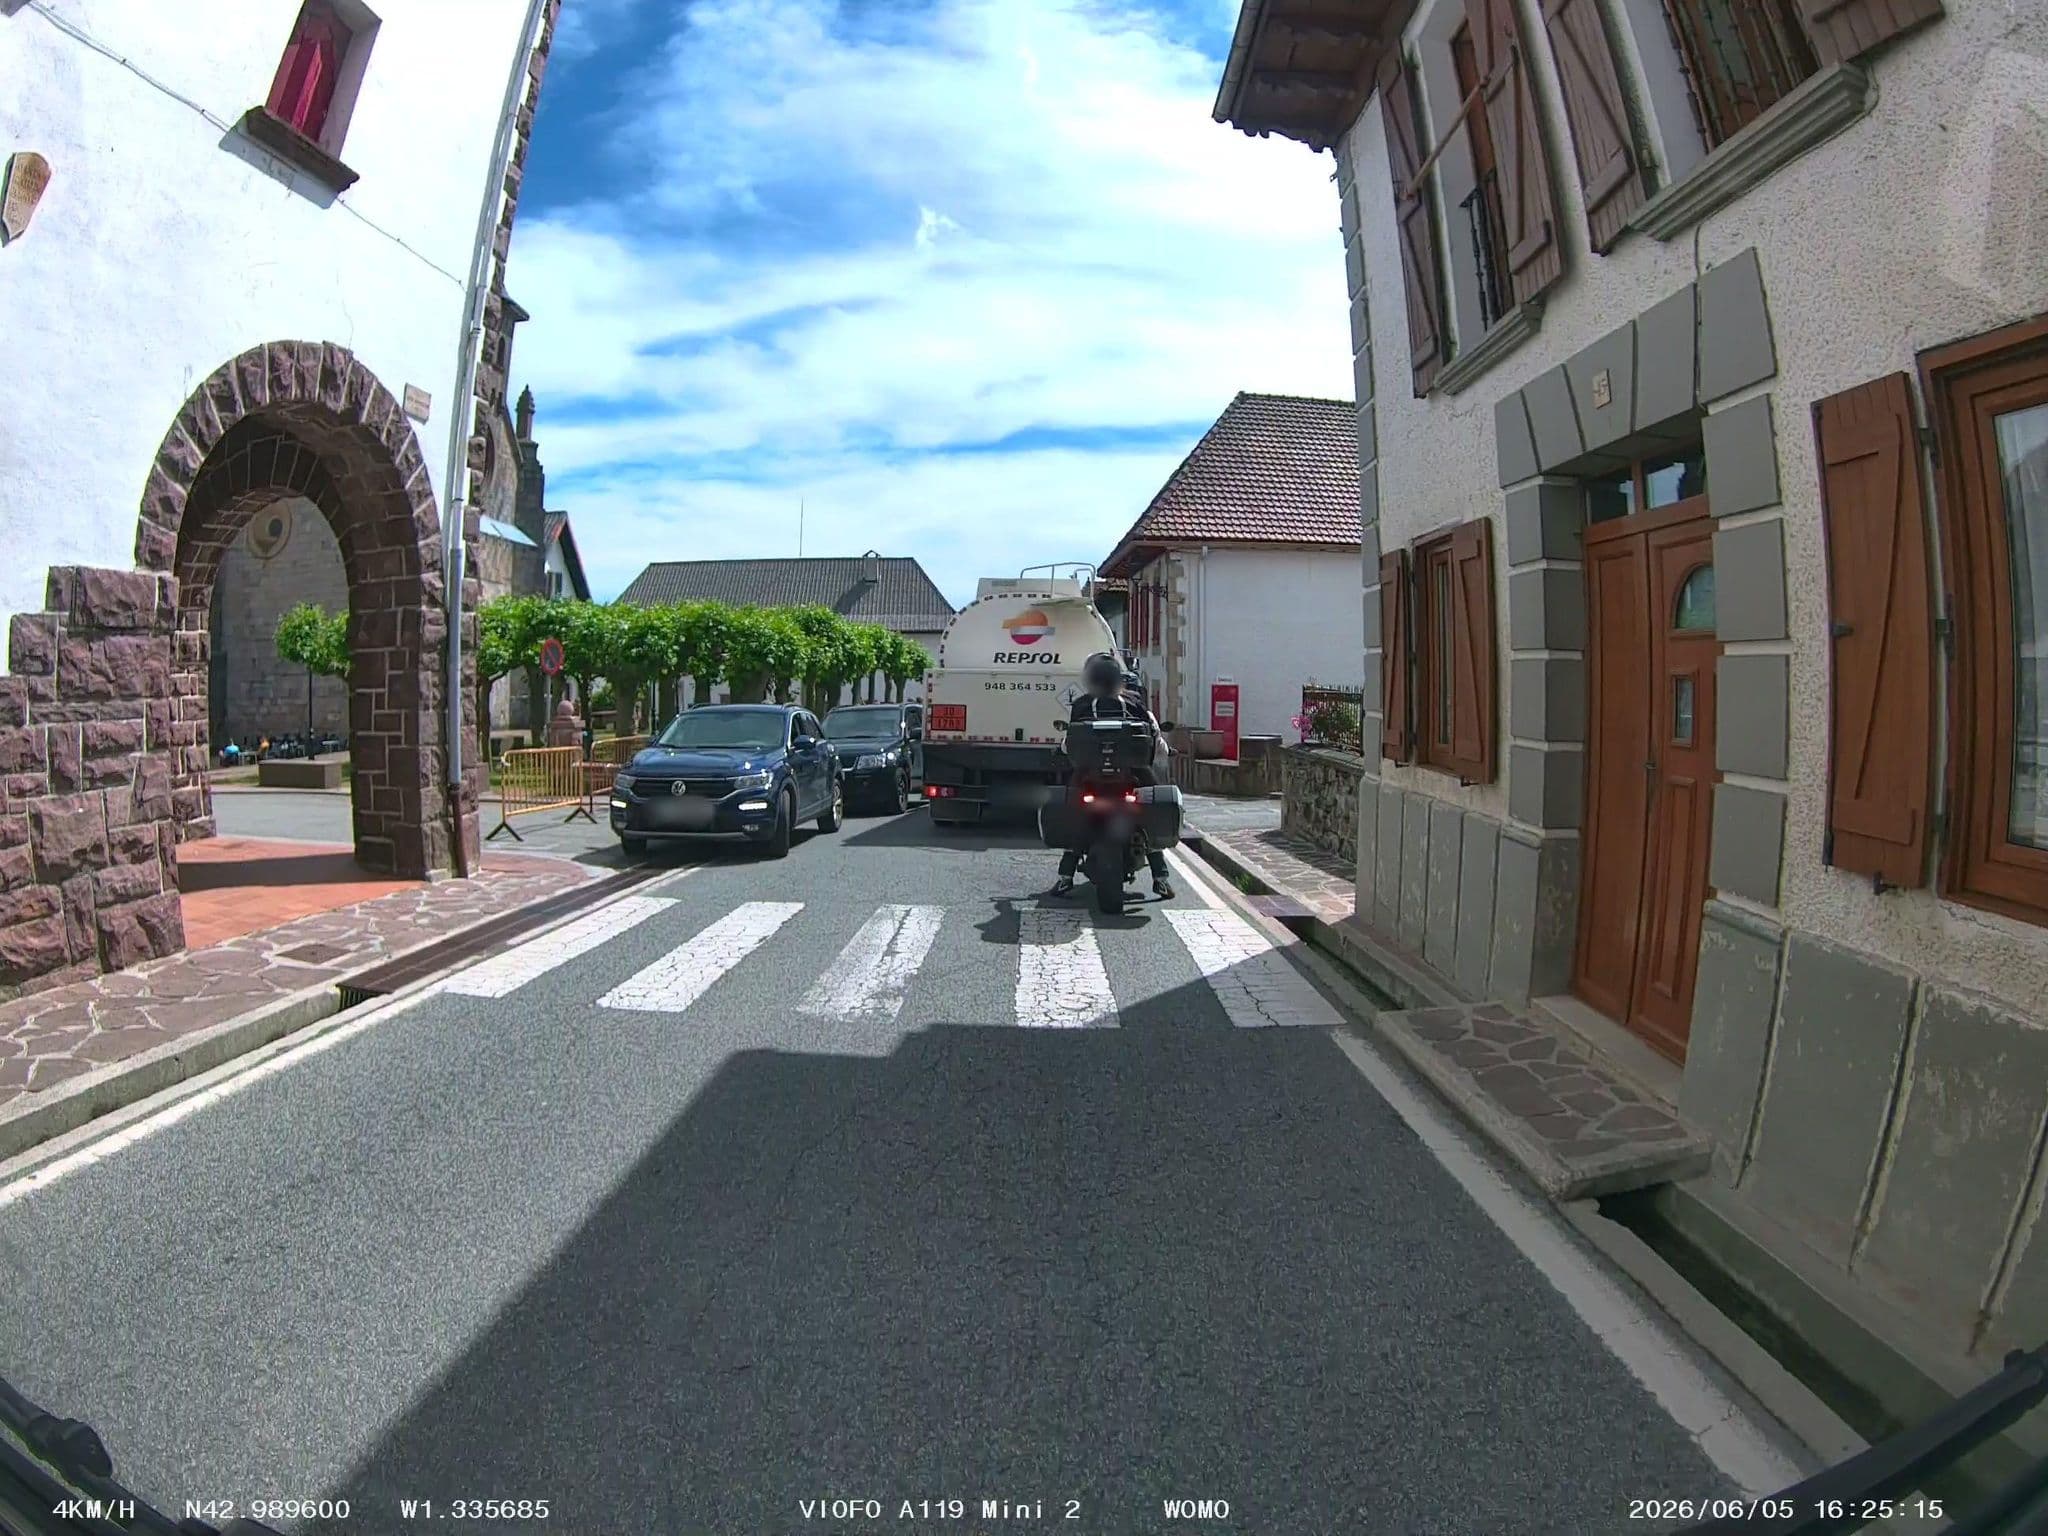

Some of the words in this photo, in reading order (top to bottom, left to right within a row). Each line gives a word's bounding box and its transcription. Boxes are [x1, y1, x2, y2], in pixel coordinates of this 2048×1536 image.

[993, 652, 1062, 665] REPSOL
[984, 682, 1006, 691] 948
[1009, 682, 1031, 691] 364
[1035, 683, 1057, 692] 533
